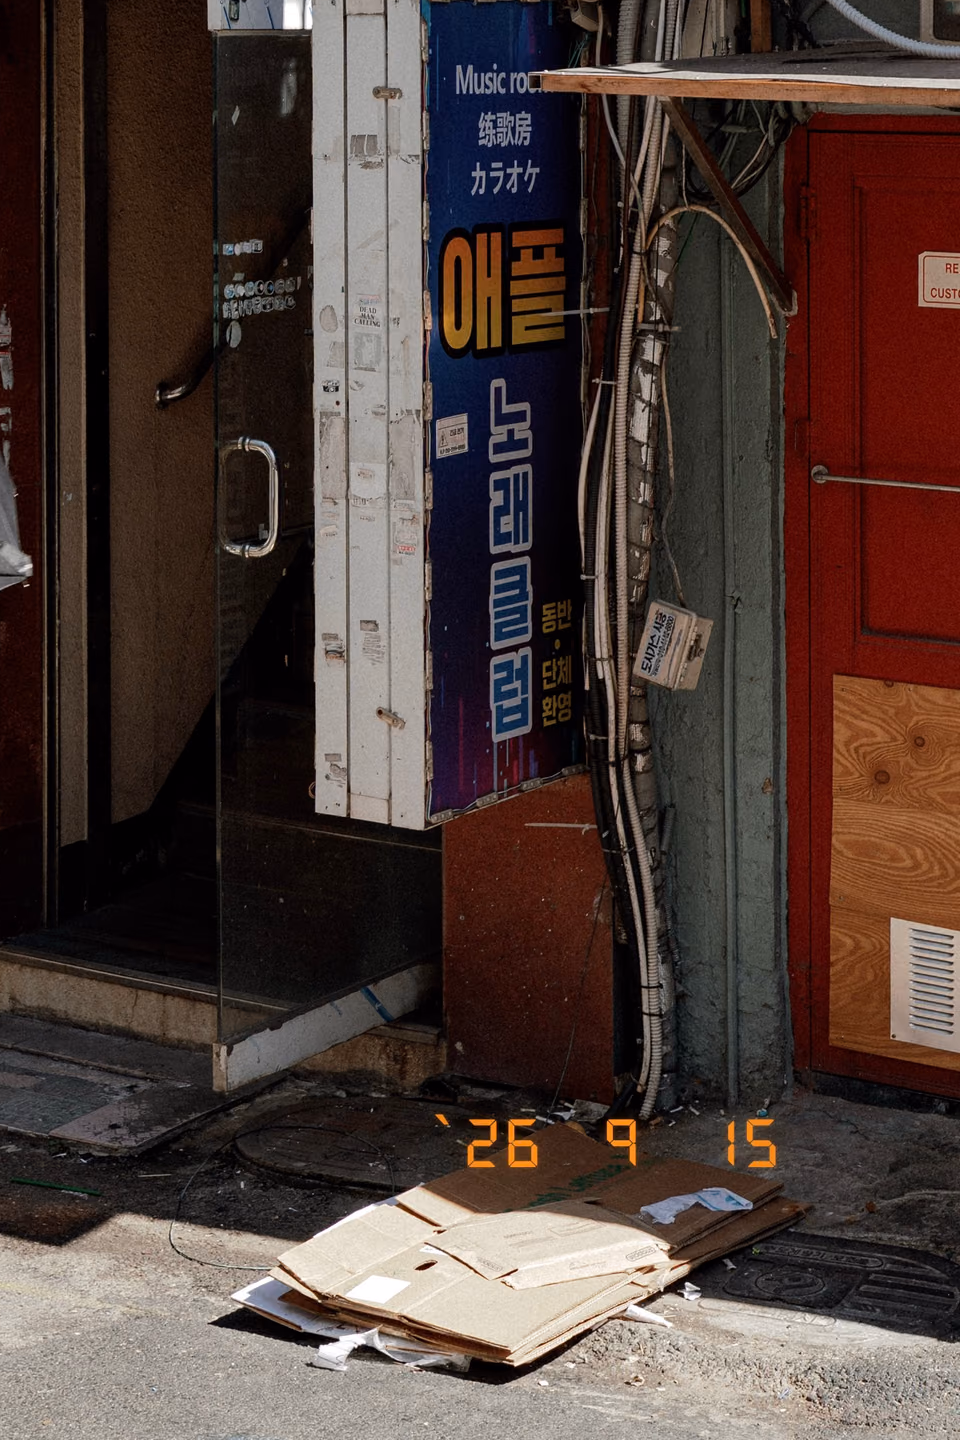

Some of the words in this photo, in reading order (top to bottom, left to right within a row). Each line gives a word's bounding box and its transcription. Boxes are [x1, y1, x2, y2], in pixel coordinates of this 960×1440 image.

[456, 63, 506, 94] Music
[478, 111, 532, 147] 练歌房
[471, 160, 540, 196] カラオケ
[442, 228, 566, 350] 애플
[489, 378, 533, 743] 노래클럽
[541, 599, 572, 633] 동반
[641, 634, 661, 674] 도시가스
[541, 656, 572, 689] 단체
[541, 691, 572, 728] 환영
